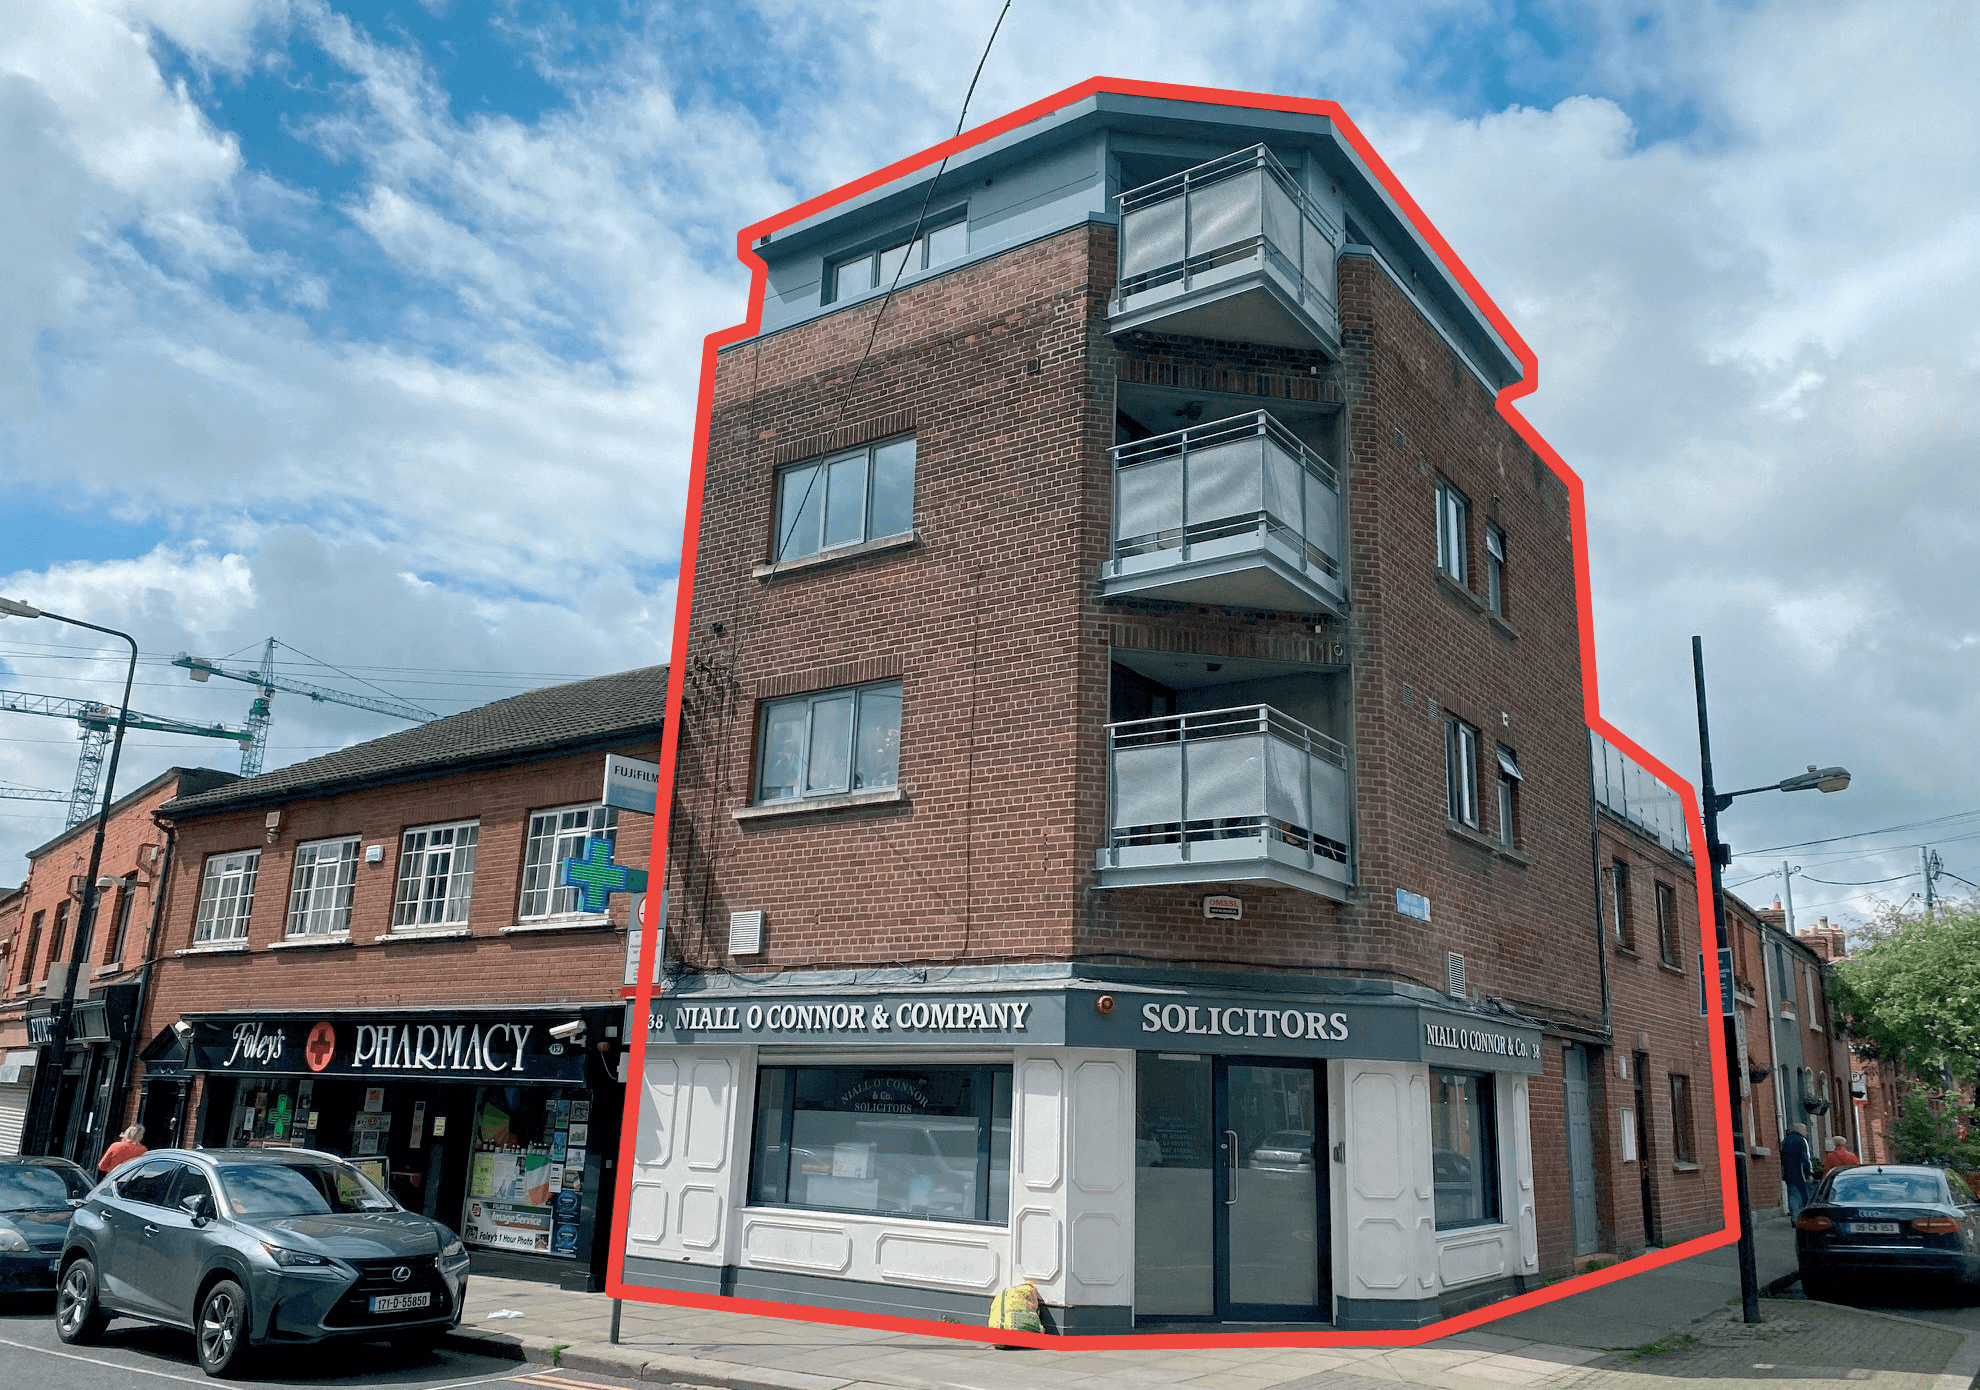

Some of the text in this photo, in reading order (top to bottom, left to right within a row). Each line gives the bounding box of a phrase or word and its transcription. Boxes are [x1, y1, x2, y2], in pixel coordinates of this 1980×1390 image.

[614, 765, 659, 783] FUJIFILM
[648, 1002, 1030, 1030] 38 NIALL O CONNOR & COMPANY
[1142, 1003, 1349, 1041] SOLICITORS
[223, 1021, 533, 1072] Foley's PHARMACY
[1426, 1024, 1540, 1059] NIALL O CONNOR & Co. 38
[841, 1081, 871, 1105] NIALL
[872, 1091, 878, 1100] &
[854, 1102, 912, 1113] SOLICITORS
[491, 1211, 542, 1226] ImageService
[479, 1231, 498, 1242] Foley's
[503, 1234, 517, 1243] Hour
[517, 1235, 534, 1246] Photo
[378, 1295, 428, 1310] 171-D-55850
